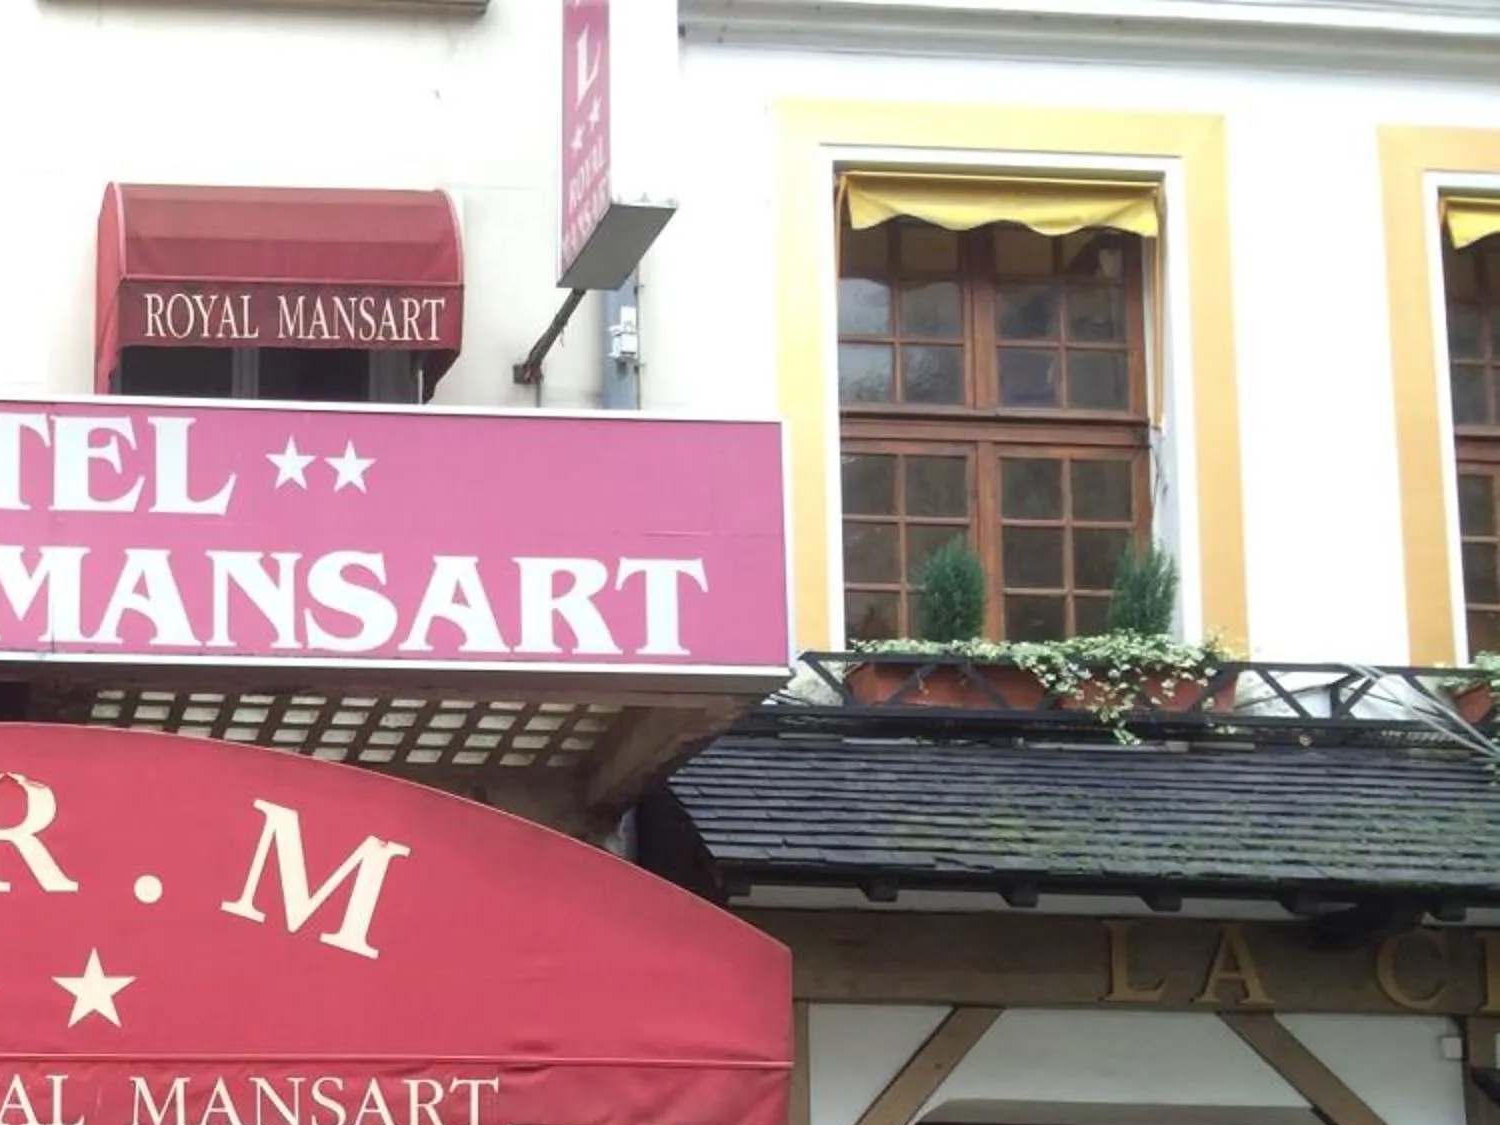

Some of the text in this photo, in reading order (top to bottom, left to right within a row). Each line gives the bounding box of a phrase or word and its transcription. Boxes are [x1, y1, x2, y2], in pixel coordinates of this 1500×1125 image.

[143, 293, 445, 342] ROYAL MANSART
[1101, 919, 1278, 1006] LA
